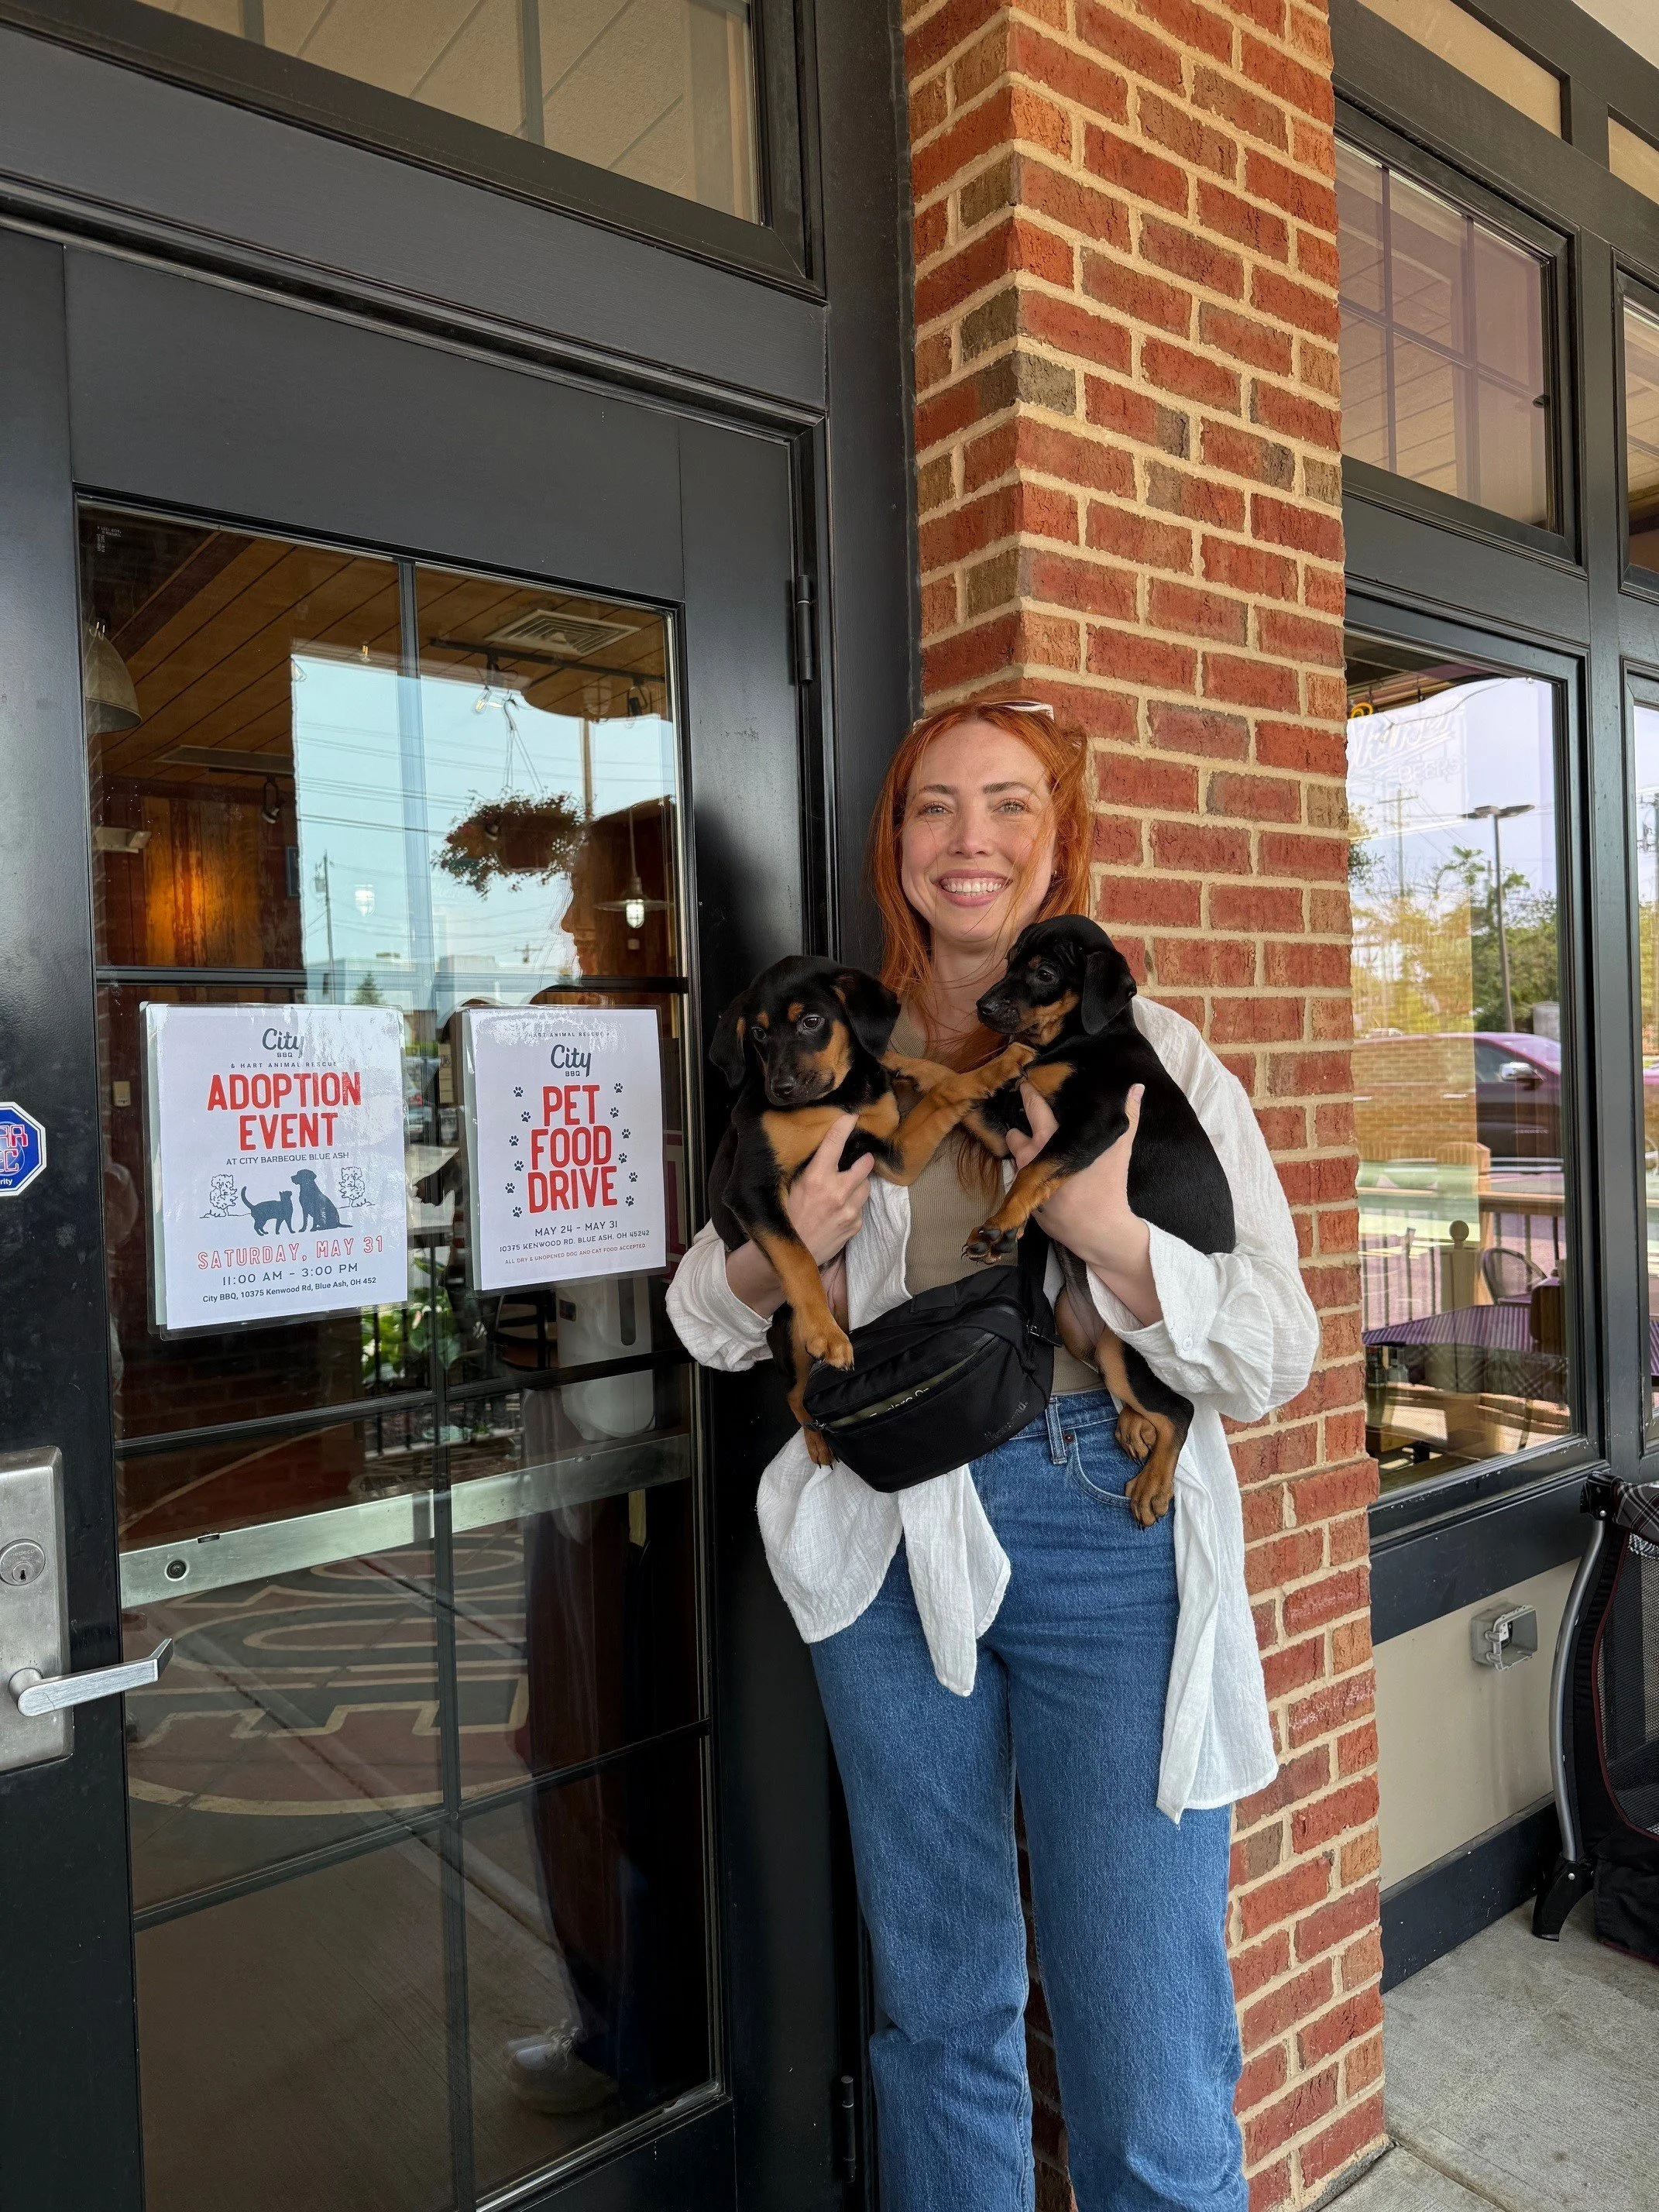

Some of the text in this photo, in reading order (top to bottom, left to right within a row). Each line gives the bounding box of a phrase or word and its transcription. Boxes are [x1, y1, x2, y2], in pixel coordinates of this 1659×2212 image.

[263, 1028, 304, 1059] City
[551, 1044, 592, 1077] City
[207, 1072, 361, 1111] ADOPTION
[543, 1085, 600, 1126] PET
[239, 1113, 338, 1151] EVENT
[531, 1126, 612, 1170] FOOD
[239, 1156, 259, 1165] CITY
[260, 1154, 307, 1163] BARBEQUE
[309, 1152, 331, 1161] BLUE
[527, 1166, 617, 1213] DRIVE
[500, 1244, 520, 1252] 10375
[523, 1239, 562, 1250] KENWOOD
[578, 1235, 596, 1244] BLUE
[534, 1227, 557, 1237] MAY
[561, 1224, 573, 1235] 24
[585, 1221, 606, 1231] MAY
[609, 1220, 618, 1229] 31
[198, 1235, 383, 1269] SATURDAY, MAY 31
[534, 1252, 565, 1261] UNOPENED
[203, 1294, 218, 1303] City
[219, 1292, 239, 1301] BBQ,
[241, 1290, 264, 1298] 10375
[266, 1285, 300, 1296] Kenwood
[301, 1283, 314, 1292] Rd,
[315, 1282, 331, 1290] Blue
[333, 1279, 349, 1289] Ash,
[362, 1276, 376, 1285] 452
[222, 1273, 256, 1286] 11:00
[263, 1270, 283, 1282] AM
[301, 1266, 332, 1277] 3:00
[339, 1262, 358, 1273] PM
